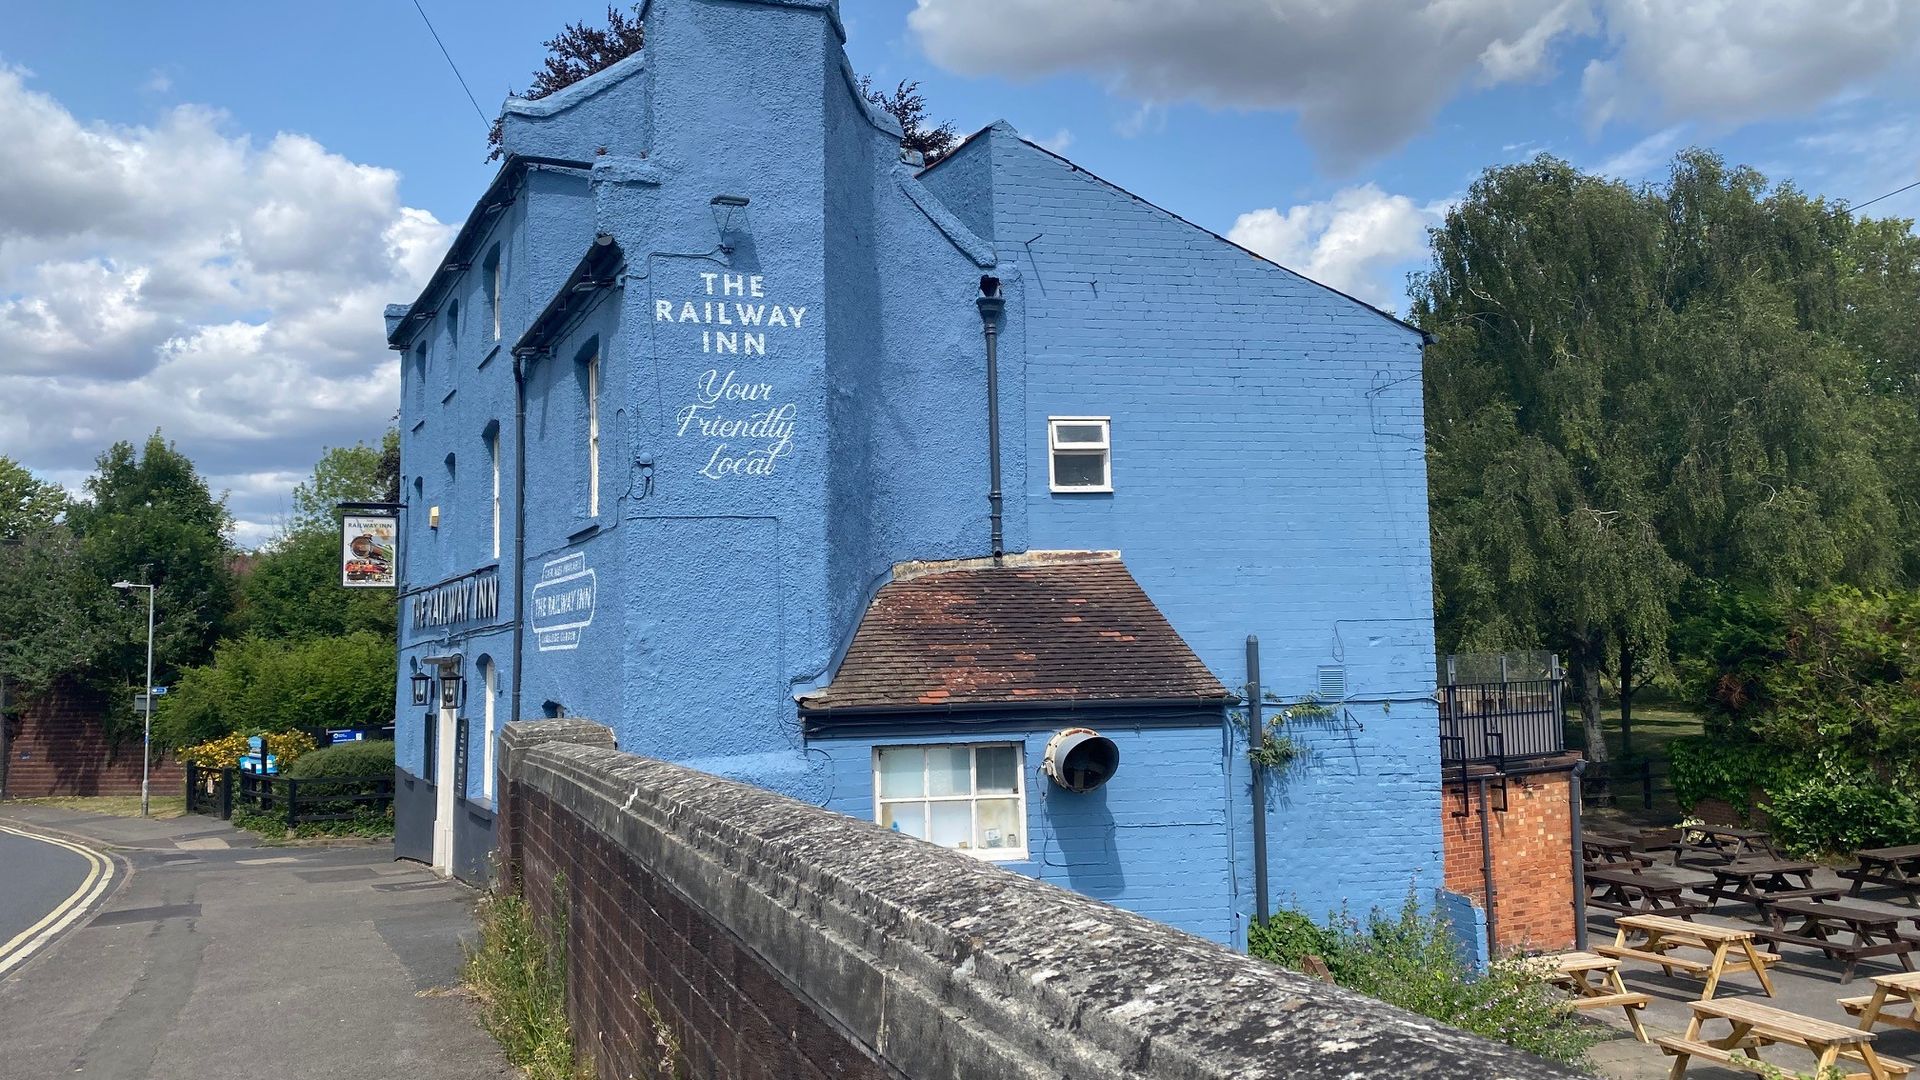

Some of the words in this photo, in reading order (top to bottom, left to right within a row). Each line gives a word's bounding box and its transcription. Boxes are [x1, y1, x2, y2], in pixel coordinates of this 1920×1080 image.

[700, 272, 764, 298] THE
[656, 299, 807, 328] RAILWAY
[702, 331, 765, 355] INN
[698, 369, 773, 404] Your
[676, 403, 797, 457] Friendly
[698, 443, 777, 480] Local
[426, 582, 470, 626] RAILWAY
[473, 574, 498, 620] INN
[535, 596, 546, 617] THE
[577, 586, 592, 611] INN
